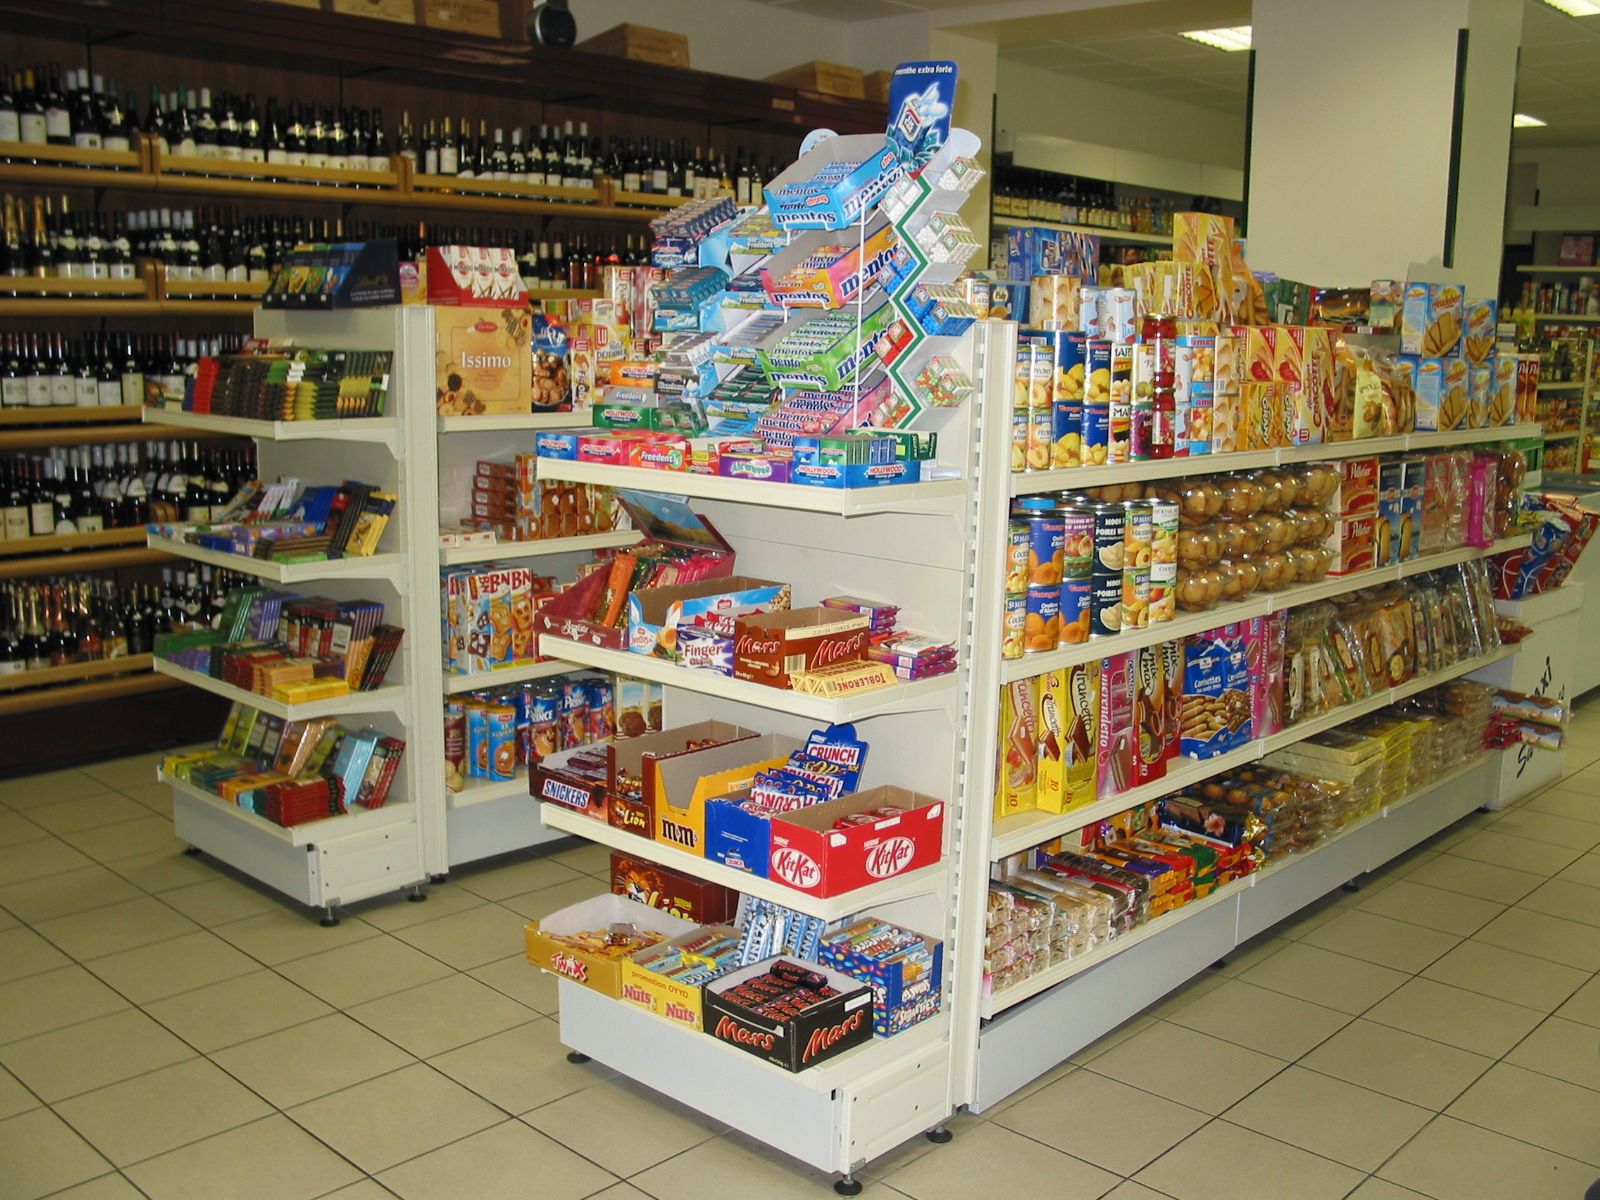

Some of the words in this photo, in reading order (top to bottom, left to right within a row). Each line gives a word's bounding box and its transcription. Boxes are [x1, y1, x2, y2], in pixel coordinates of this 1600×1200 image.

[918, 66, 935, 74] extra
[936, 65, 953, 73] forte
[775, 211, 837, 223] mentos
[773, 291, 831, 303] mentos
[461, 351, 511, 369] Issimo
[772, 372, 828, 386] mentos
[605, 410, 638, 418] HOLLYWOOD
[761, 418, 803, 430] mentos
[640, 451, 674, 463] Freedent
[800, 466, 836, 475] HOLLYWOOD
[869, 465, 904, 474] HOLLYWOOD
[684, 643, 723, 660] Finger
[735, 635, 781, 654] Mars
[811, 632, 864, 669] Mars
[836, 673, 887, 692] TOBLERONE
[1018, 681, 1036, 733] ancetto
[1100, 674, 1109, 747] merendetto
[809, 746, 857, 765] CRUNCH
[544, 781, 588, 808] SNICKERS
[1009, 794, 1018, 808] 10
[623, 809, 646, 829] Lion
[871, 839, 910, 875] KitKat
[777, 851, 816, 885] KitKat
[632, 971, 667, 990] promotion
[623, 984, 652, 1006] Nuts
[665, 1002, 696, 1023] Nuts
[714, 1015, 775, 1052] Mars
[802, 1010, 864, 1064] Mars
